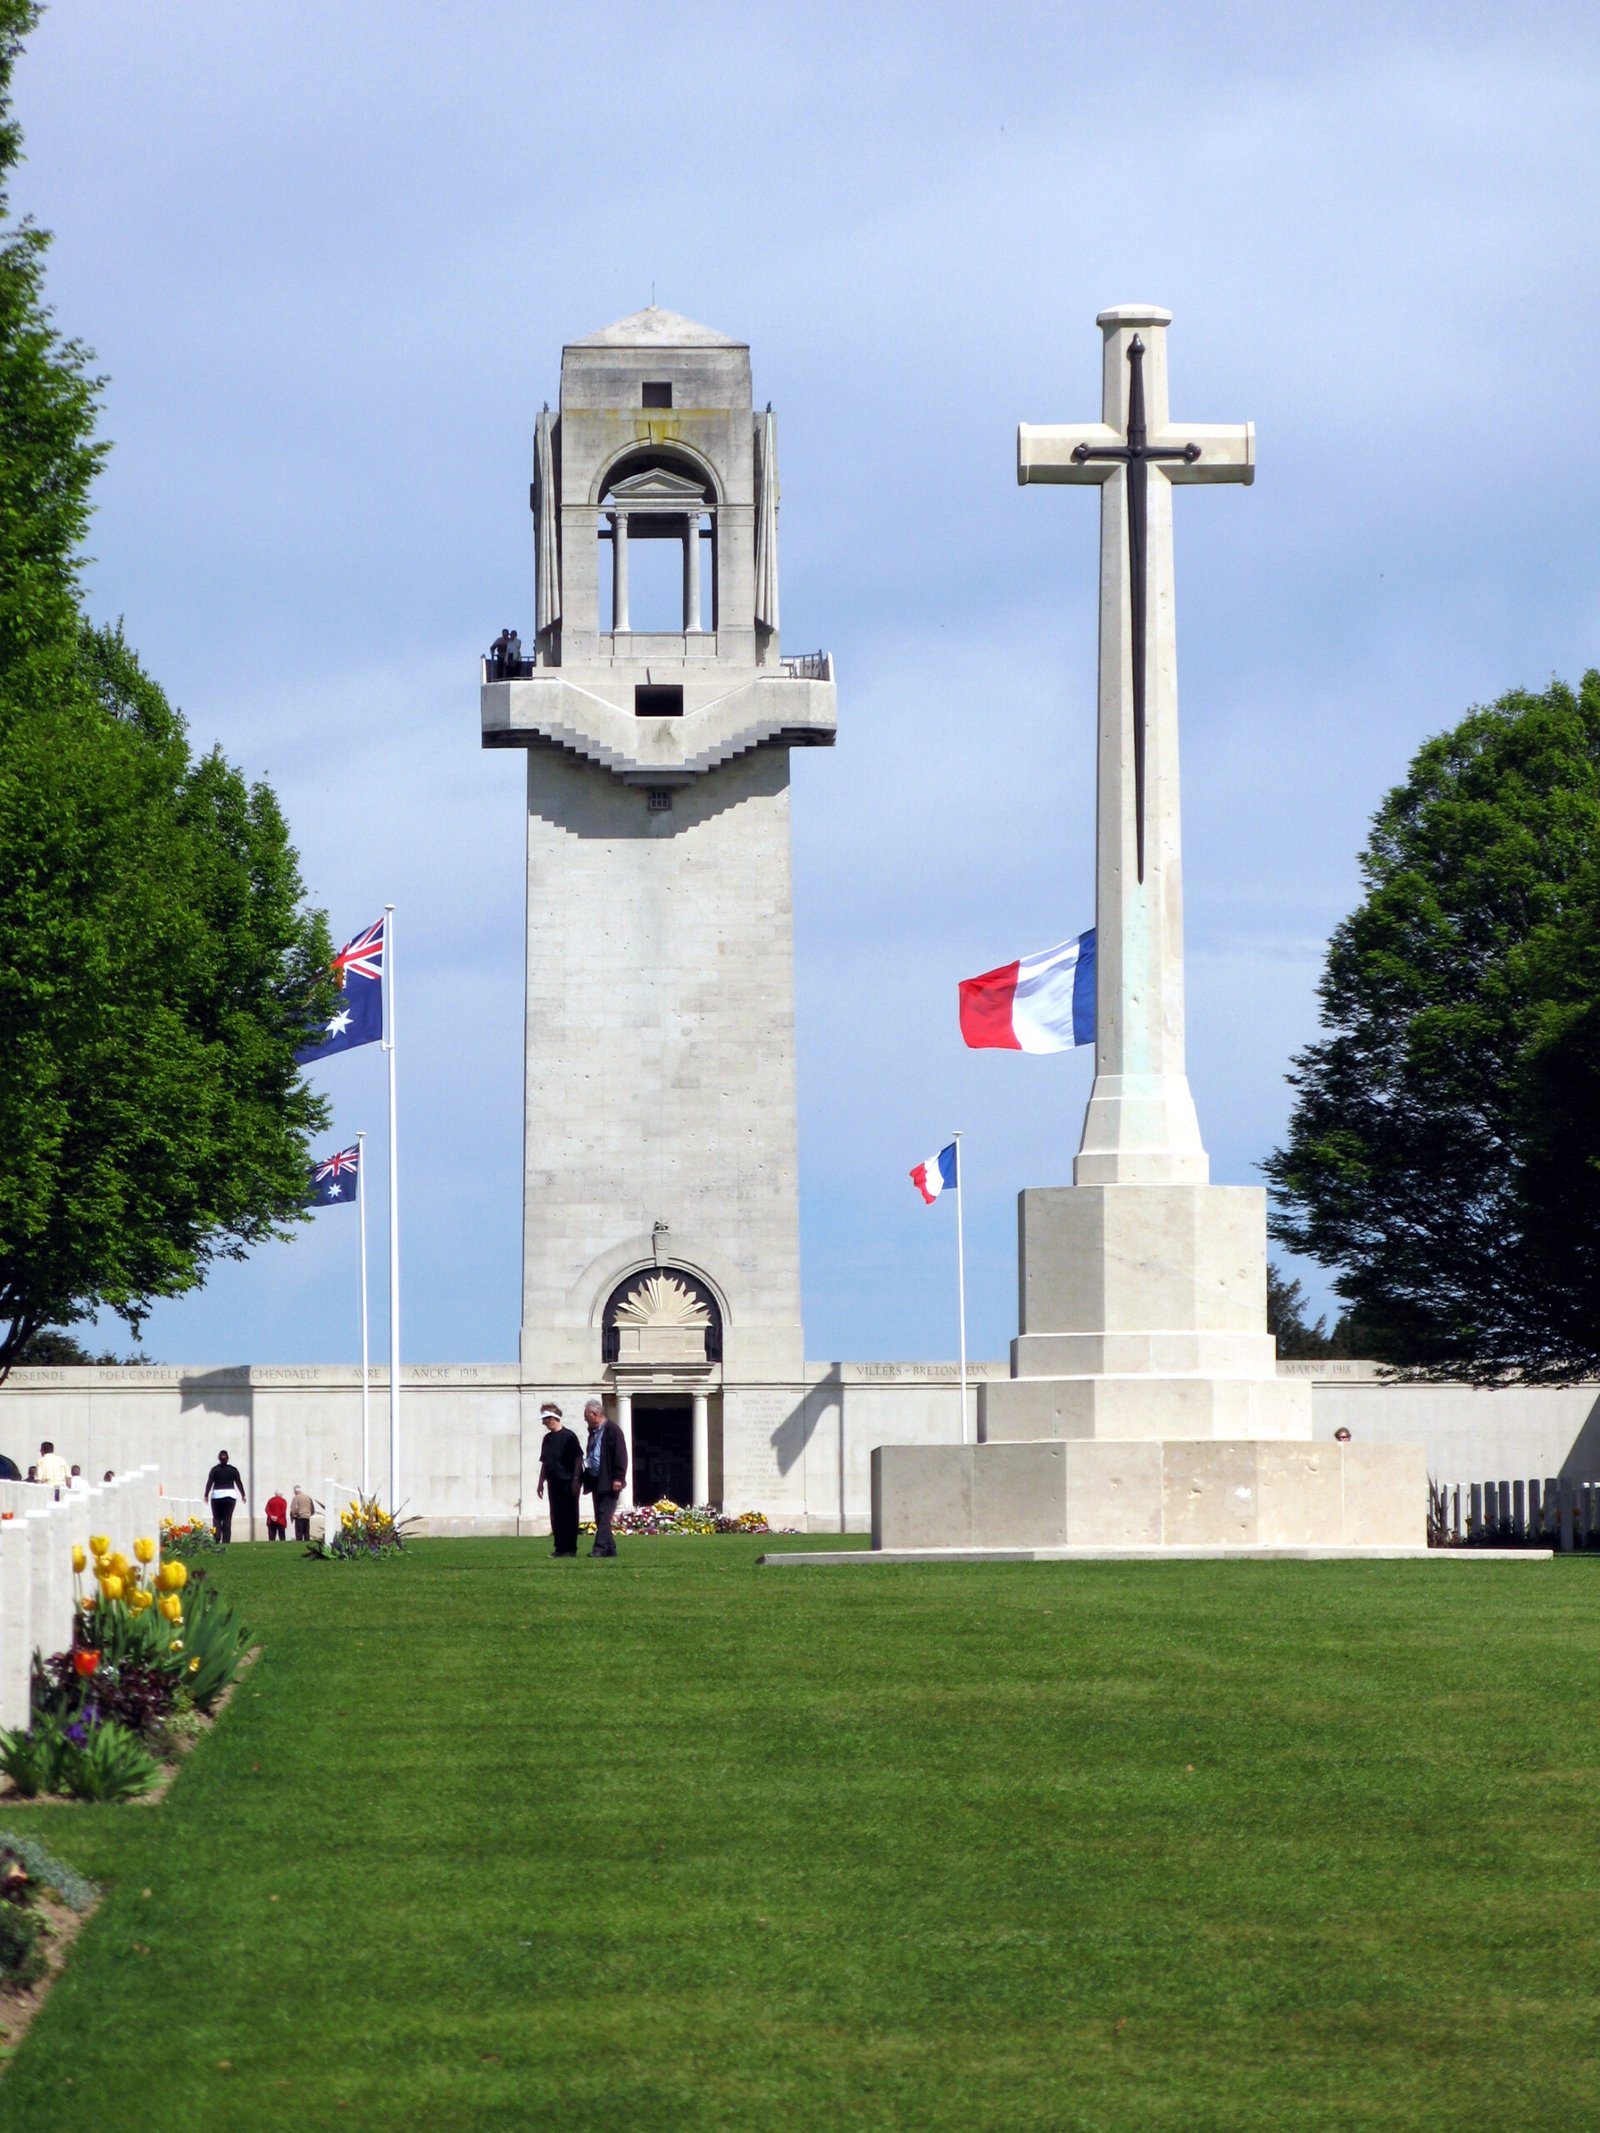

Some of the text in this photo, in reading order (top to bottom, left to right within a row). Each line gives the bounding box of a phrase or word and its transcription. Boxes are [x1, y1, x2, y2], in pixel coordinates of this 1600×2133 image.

[99, 1370, 189, 1381] POELCAPPELLE
[412, 1367, 450, 1379] ANCRE
[460, 1367, 479, 1378] 1918
[856, 1365, 902, 1377] VILLERS
[913, 1365, 988, 1377] BRETONEUX
[1285, 1365, 1352, 1375] MARNE 1918
